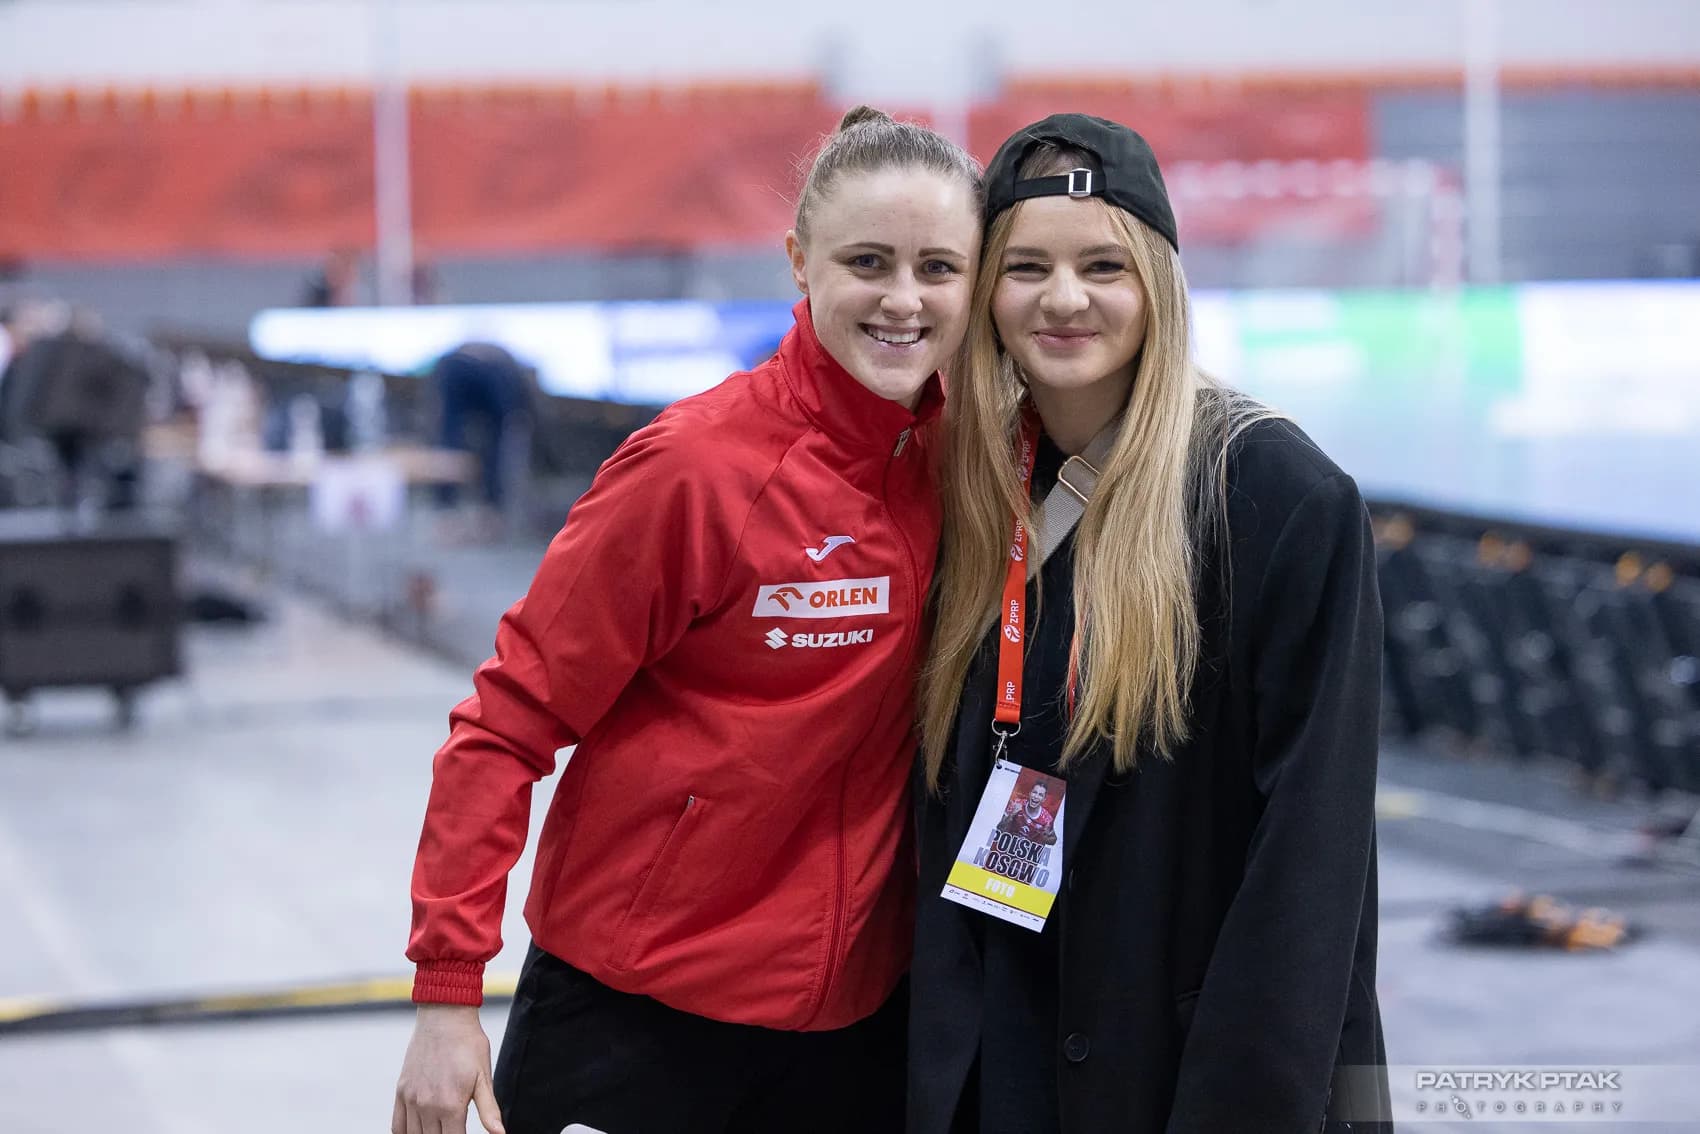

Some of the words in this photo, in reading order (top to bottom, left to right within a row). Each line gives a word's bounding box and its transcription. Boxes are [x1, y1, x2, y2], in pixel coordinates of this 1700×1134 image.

[809, 587, 878, 609] ORLEN
[1010, 599, 1019, 624] ZPRP
[791, 629, 874, 648] SUZUKI
[1006, 681, 1015, 702] PRP
[986, 829, 1052, 867] POLSKA
[973, 846, 1050, 888] KOSOWO
[985, 877, 1016, 899] FOTO
